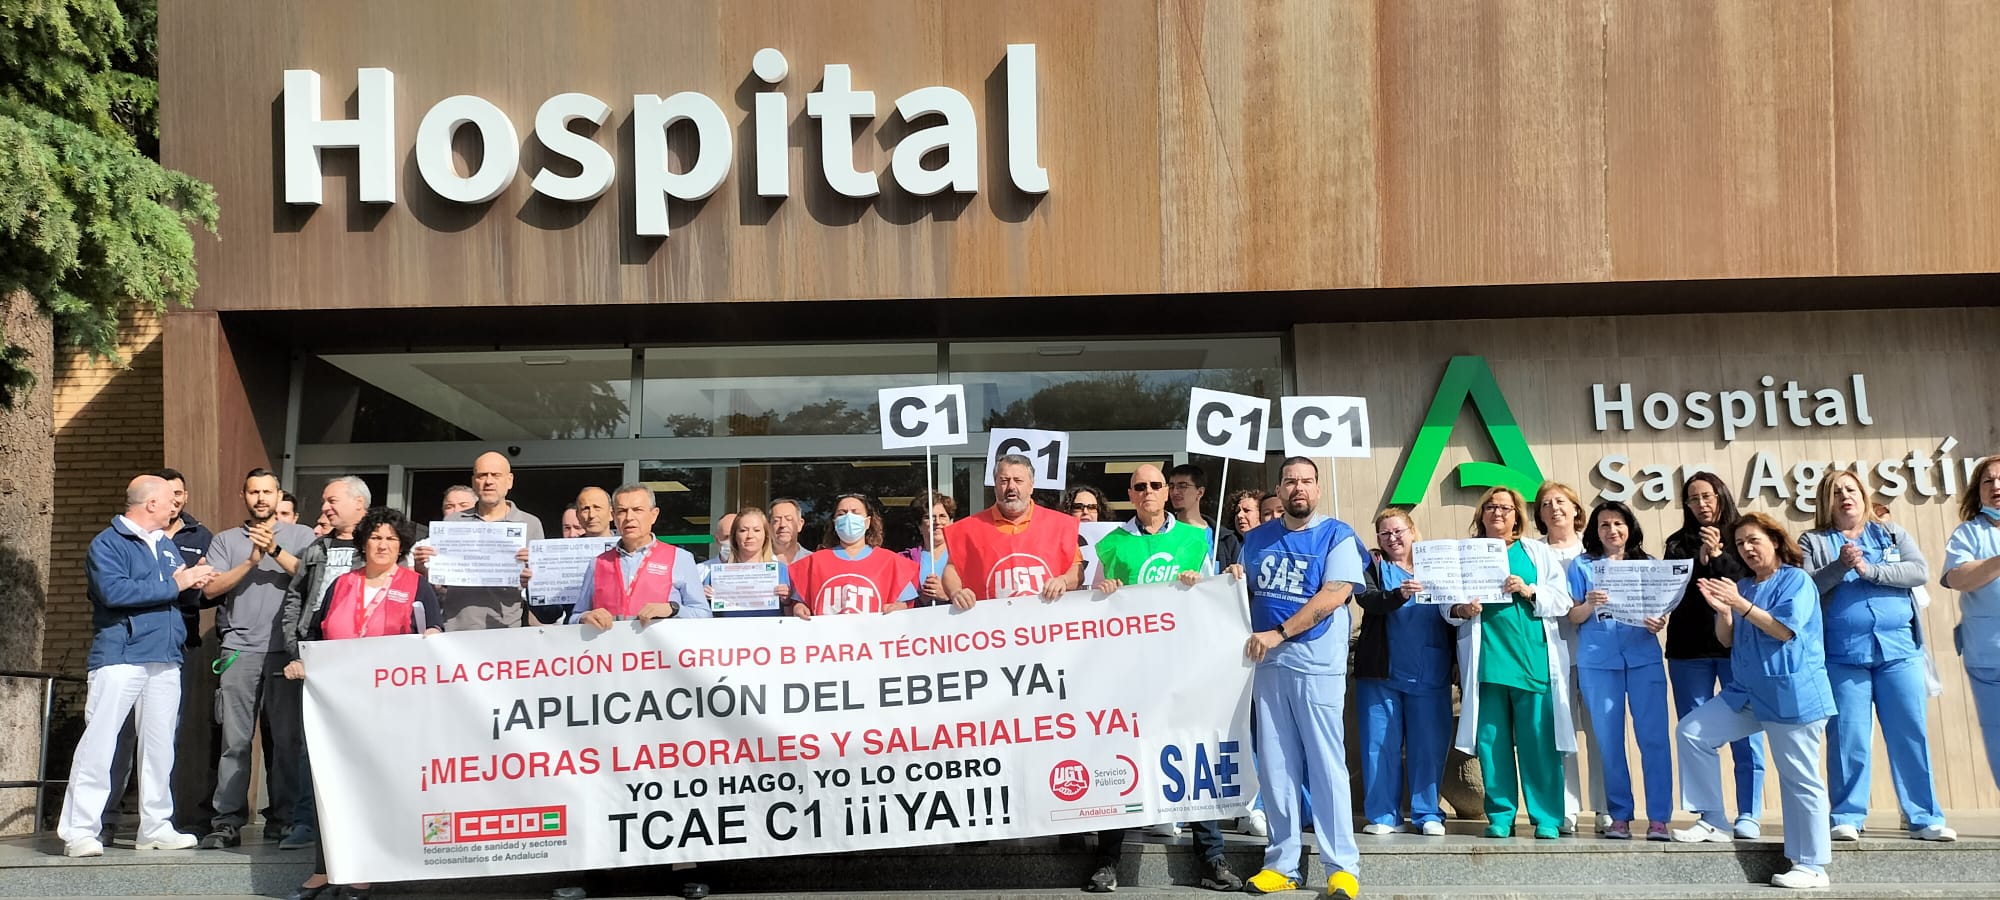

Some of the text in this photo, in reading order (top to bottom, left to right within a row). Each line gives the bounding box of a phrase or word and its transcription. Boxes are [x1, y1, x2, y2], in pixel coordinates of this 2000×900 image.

[283, 43, 1050, 237] Hospital
[888, 394, 961, 438] C1
[1195, 401, 1263, 451] C1
[1291, 406, 1363, 447] C1
[1592, 373, 1874, 441] Hospital
[1598, 453, 1715, 502] Sa
[994, 566, 1045, 599] UGT
[1145, 564, 1180, 583] CSIF
[823, 584, 874, 615] UGT
[374, 612, 1175, 688] POR LA CREACIÓN DEL GRUPO B PARA TÉCNICOS SUPERIORES
[493, 676, 766, 739] ¡APLICACIÓN
[784, 680, 864, 714] DEL
[879, 670, 988, 707] EBEP
[421, 748, 600, 791] ¡MEJORAS
[613, 734, 820, 772] LABORALES
[831, 731, 852, 757] Y
[863, 712, 1077, 755] SALARIALES
[626, 758, 1001, 801] YO LO HAGO, YO LO COBRO
[1054, 765, 1084, 785] UGT
[1094, 768, 1127, 778] Servicios
[1095, 778, 1126, 788] Públicos
[460, 813, 540, 837] CCOO
[608, 804, 747, 853] TCAE
[766, 799, 822, 841] C1
[1079, 807, 1118, 817] Andalucía
[423, 839, 567, 855] federación de sanidad y sectores
[424, 851, 549, 866] sociosanitarios de Andalucía
